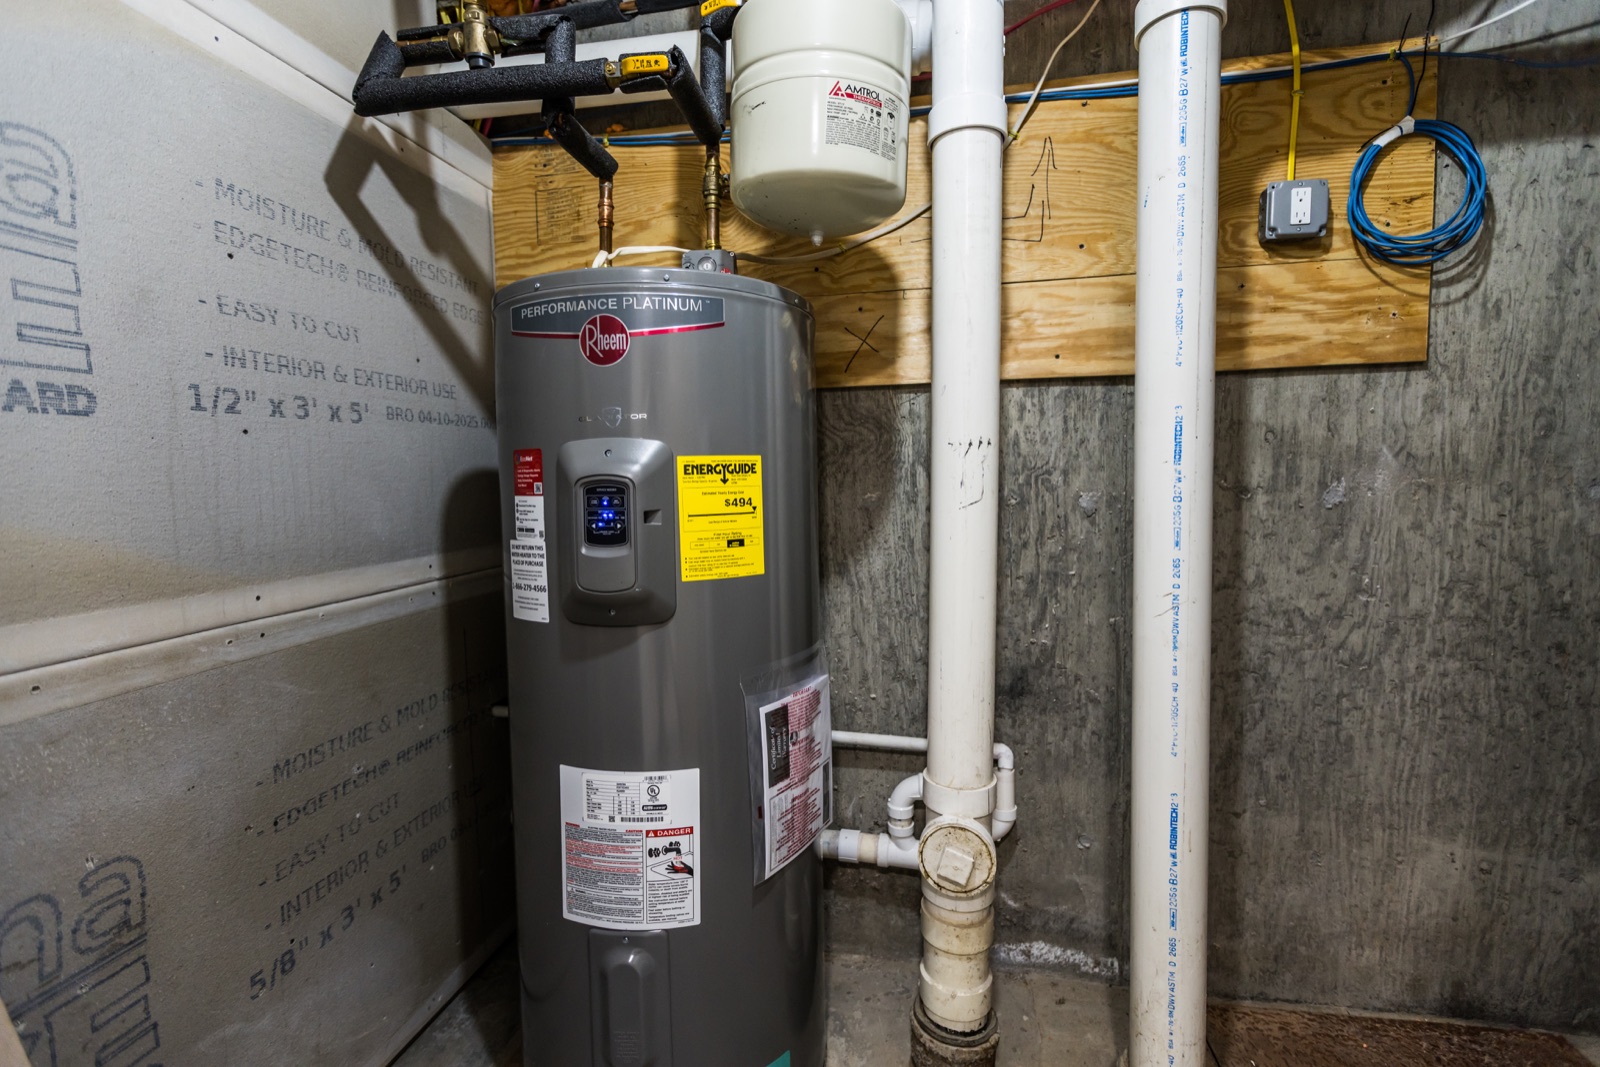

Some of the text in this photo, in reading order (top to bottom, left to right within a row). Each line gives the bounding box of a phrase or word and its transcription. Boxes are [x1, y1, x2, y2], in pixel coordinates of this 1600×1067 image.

[1179, 8, 1190, 58] ROBINTECH
[844, 84, 882, 102] AMTROL
[1176, 194, 1185, 218] ASTM
[214, 178, 331, 241] MOISTURE
[358, 235, 404, 268] MOLD
[410, 256, 479, 293] RESISTANT
[356, 269, 448, 314] REINFORCED
[453, 302, 485, 326] EDGE
[521, 298, 617, 319] PERFORMANCE
[216, 295, 359, 344] EASY TO CUT
[585, 315, 627, 358] Rheem
[223, 345, 327, 381] INTERIOR
[353, 368, 429, 396] EXTERIOR
[433, 381, 457, 400] USE
[386, 405, 414, 423] BRO
[1173, 420, 1183, 466] ROBINTECH
[724, 497, 752, 508] $494
[525, 560, 544, 568] PURCHASE
[1172, 593, 1181, 616] ASTM
[273, 721, 373, 785] MOISTURE
[397, 693, 438, 726] MOLD
[275, 791, 400, 883] EASY TO CUT
[657, 827, 691, 837] DANGER
[1169, 807, 1179, 851] ROBINTECH
[280, 849, 369, 927] INTERIOR
[393, 789, 461, 849] EXTERIOR
[1168, 937, 1177, 958] 2665
[1168, 971, 1177, 993] ASTM
